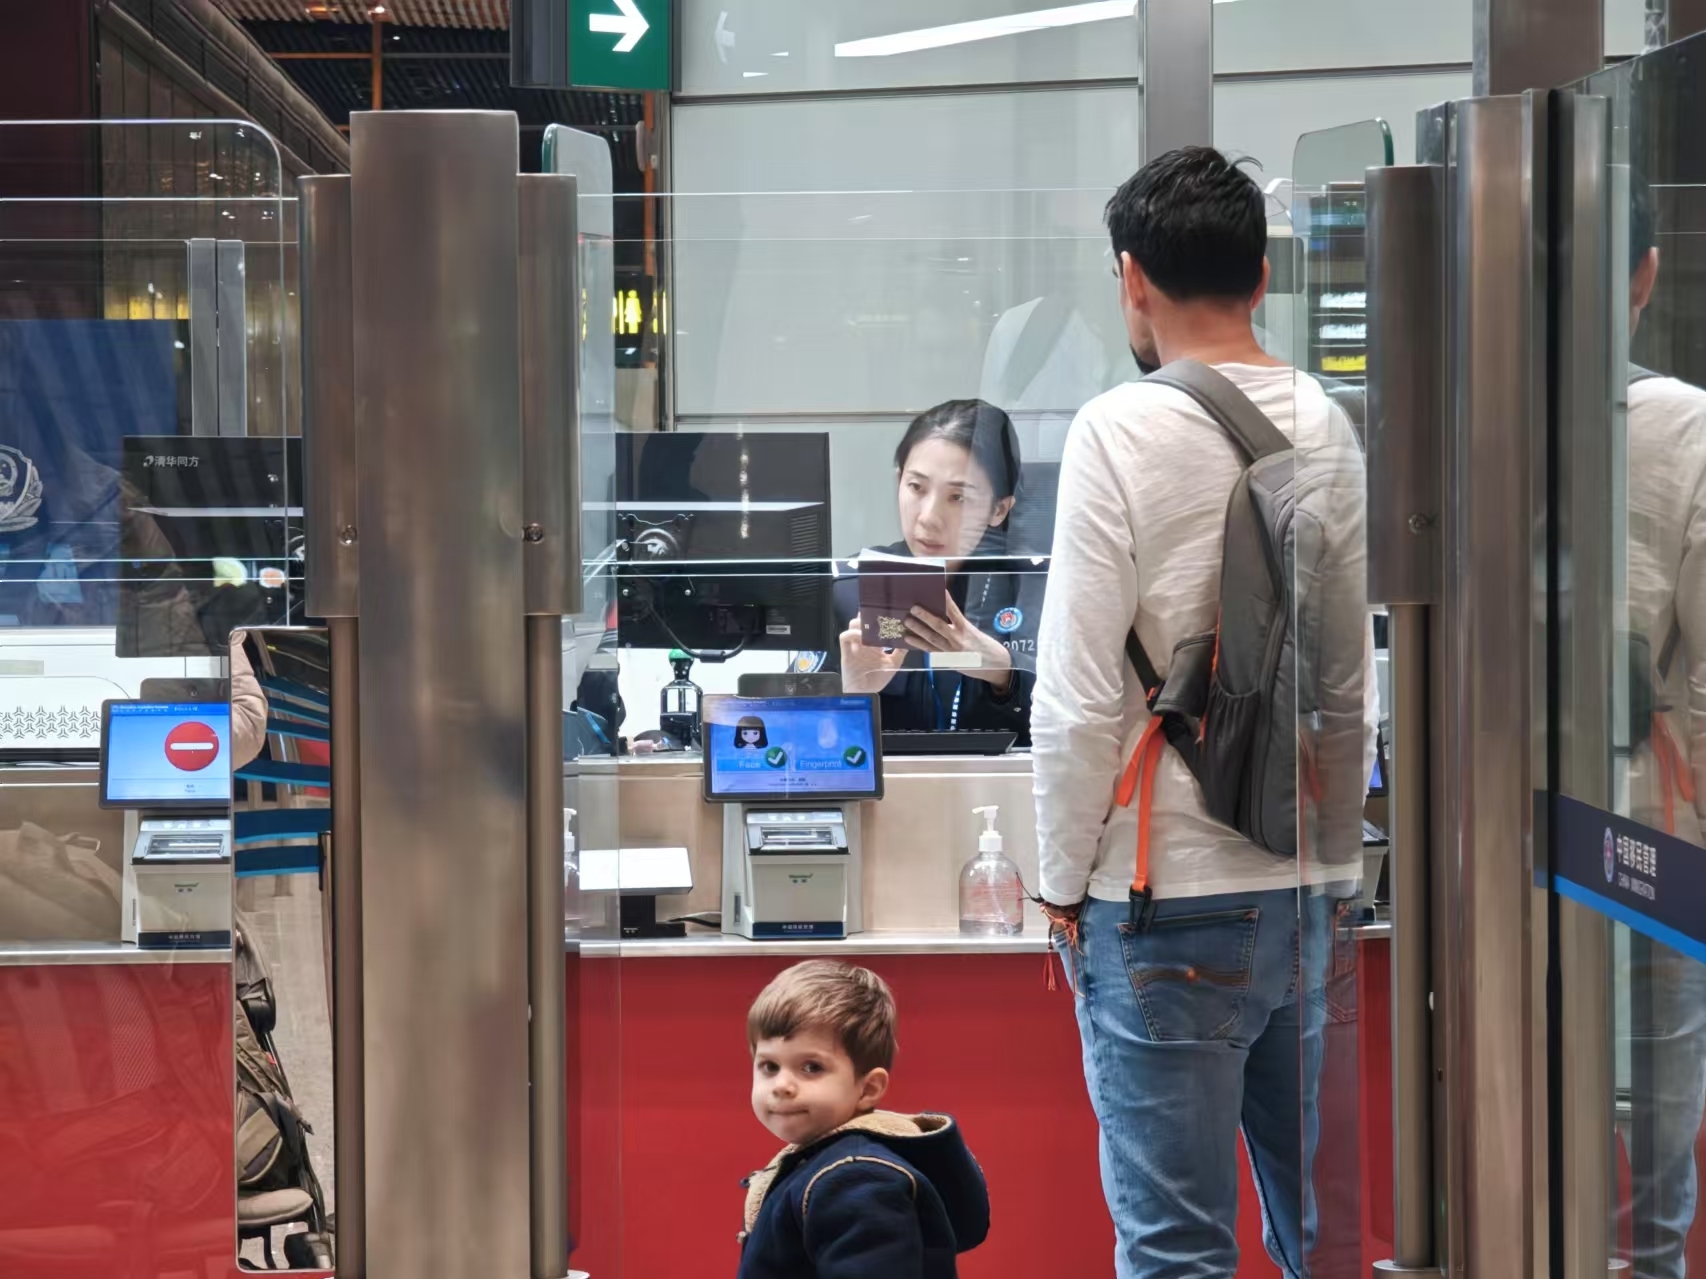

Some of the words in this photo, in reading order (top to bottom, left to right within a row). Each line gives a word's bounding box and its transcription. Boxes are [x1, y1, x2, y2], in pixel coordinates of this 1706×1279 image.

[154, 455, 200, 467] 清华同方
[738, 760, 761, 769] Face
[799, 760, 842, 770] Fingerprint
[1616, 833, 1657, 878] 中国移民管理
